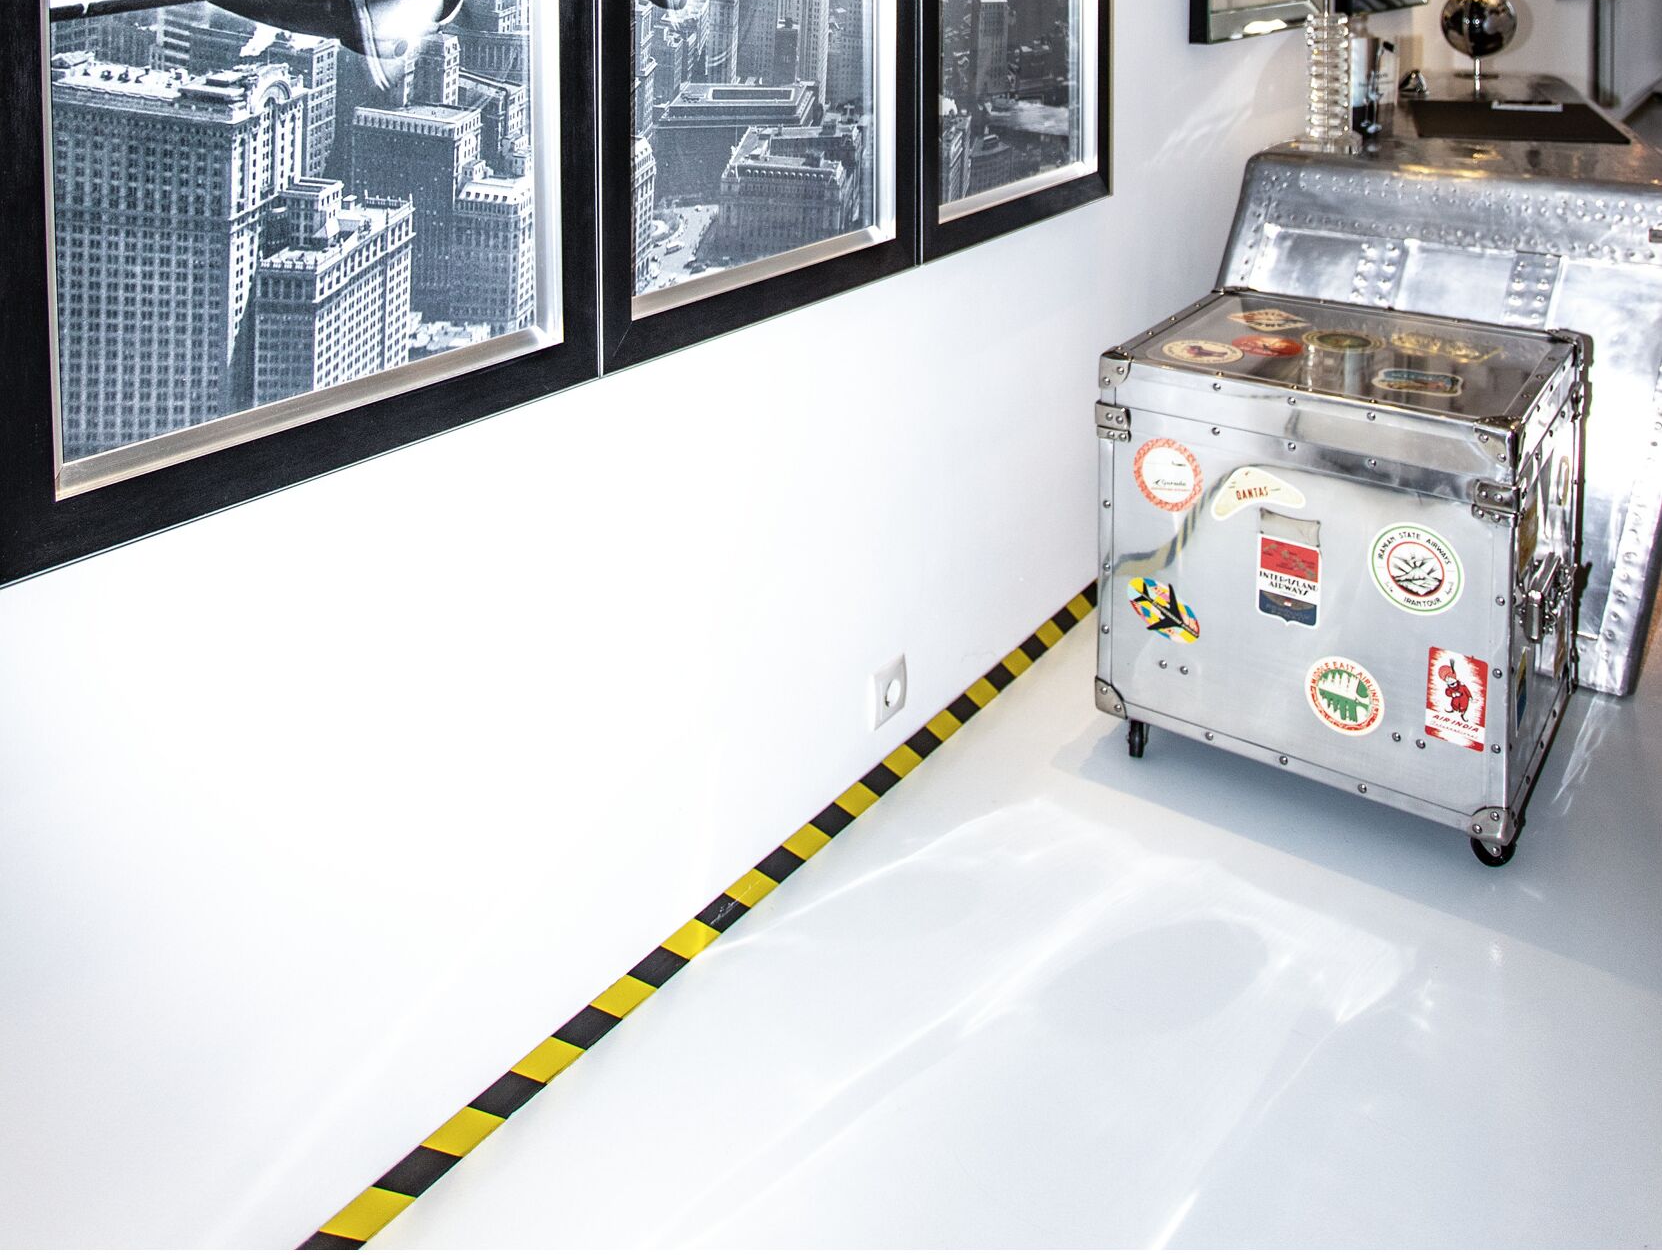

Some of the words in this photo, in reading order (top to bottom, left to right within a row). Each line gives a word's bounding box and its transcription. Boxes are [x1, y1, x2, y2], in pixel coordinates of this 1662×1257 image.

[1235, 486, 1269, 501] QANTAS
[1398, 531, 1421, 540] STATE
[1425, 538, 1452, 565] AIRWAYS
[1269, 581, 1309, 597] AIRWAYS
[1332, 661, 1356, 673] EAST
